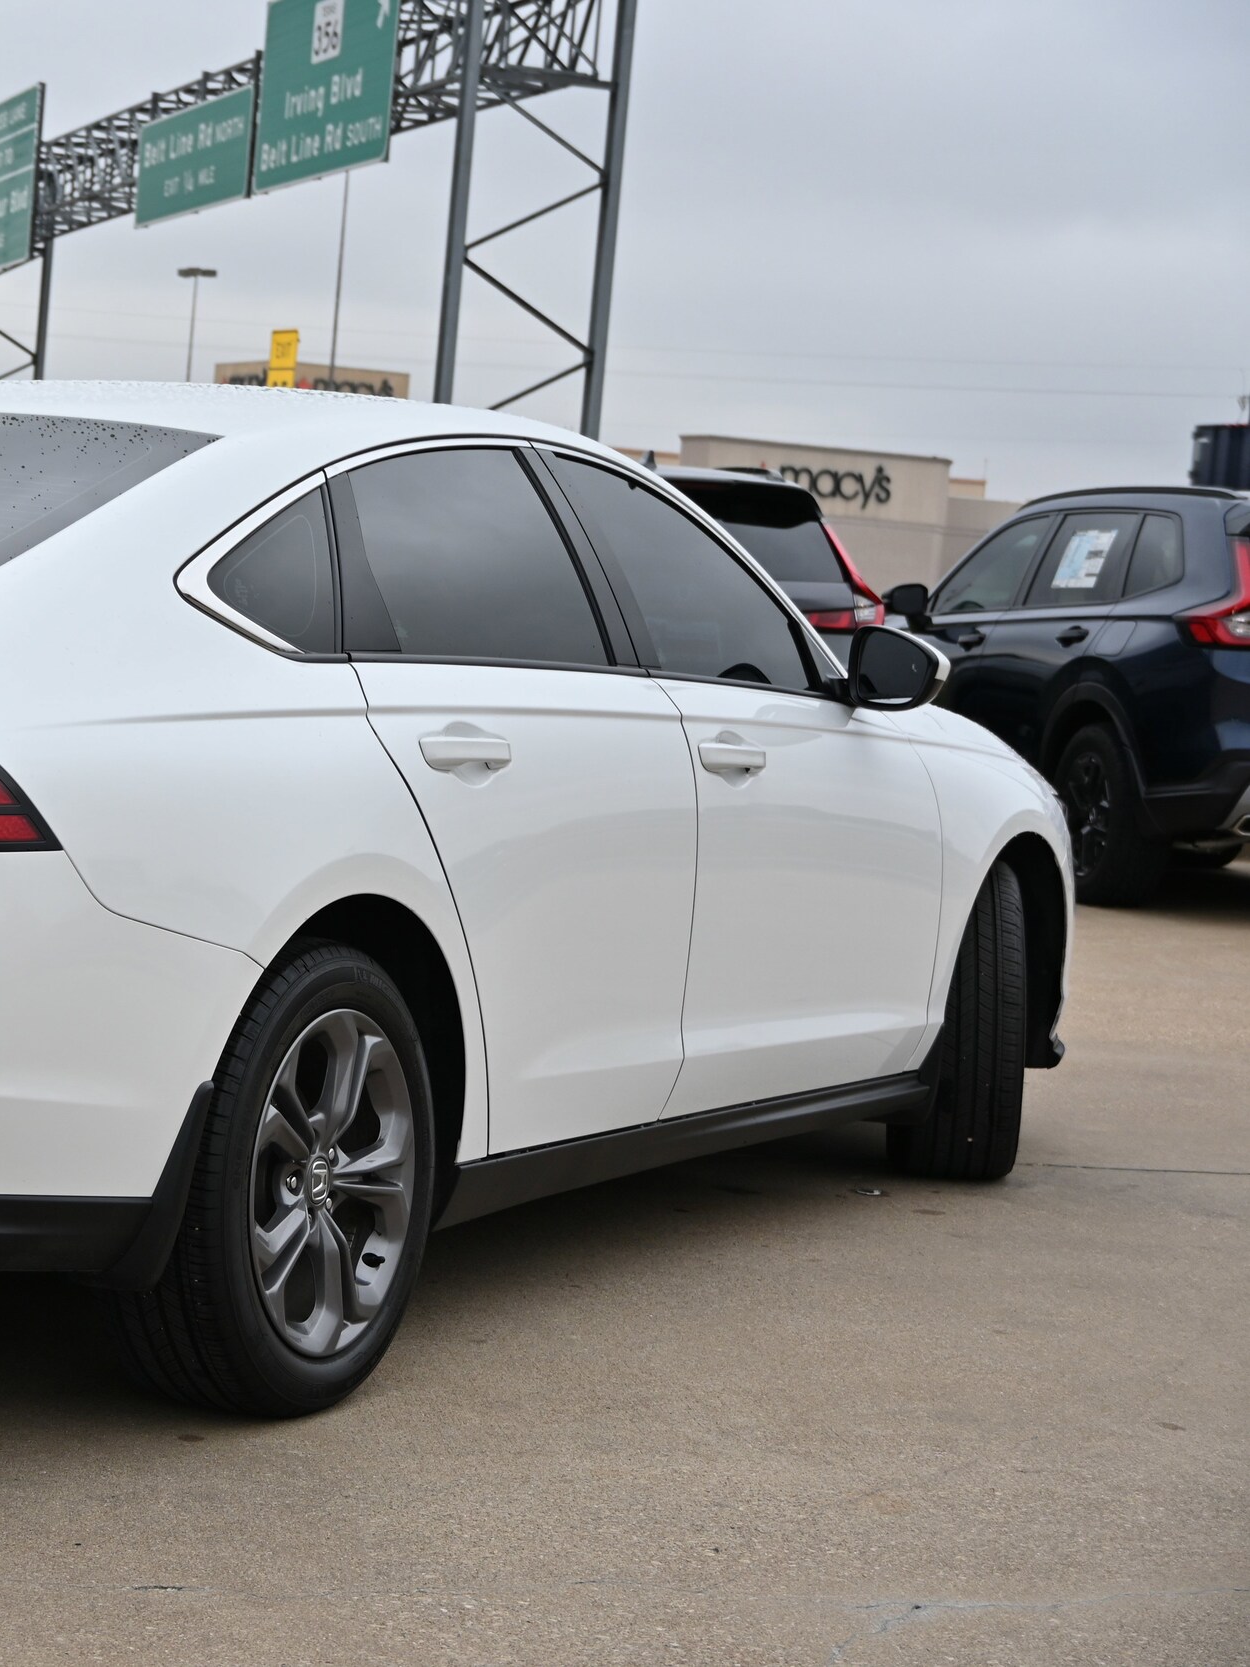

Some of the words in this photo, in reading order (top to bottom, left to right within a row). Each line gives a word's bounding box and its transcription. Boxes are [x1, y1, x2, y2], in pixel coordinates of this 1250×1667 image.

[313, 18, 339, 57] 356
[284, 84, 326, 119] Irving
[330, 67, 363, 104] Blvd
[144, 137, 166, 168] Belt
[169, 131, 194, 159] Line
[197, 121, 214, 150] Rd
[260, 138, 288, 172] Belt
[290, 132, 320, 163] Line
[324, 122, 344, 153] Rd
[346, 115, 383, 147] SOUTH
[779, 464, 891, 510] macy's
